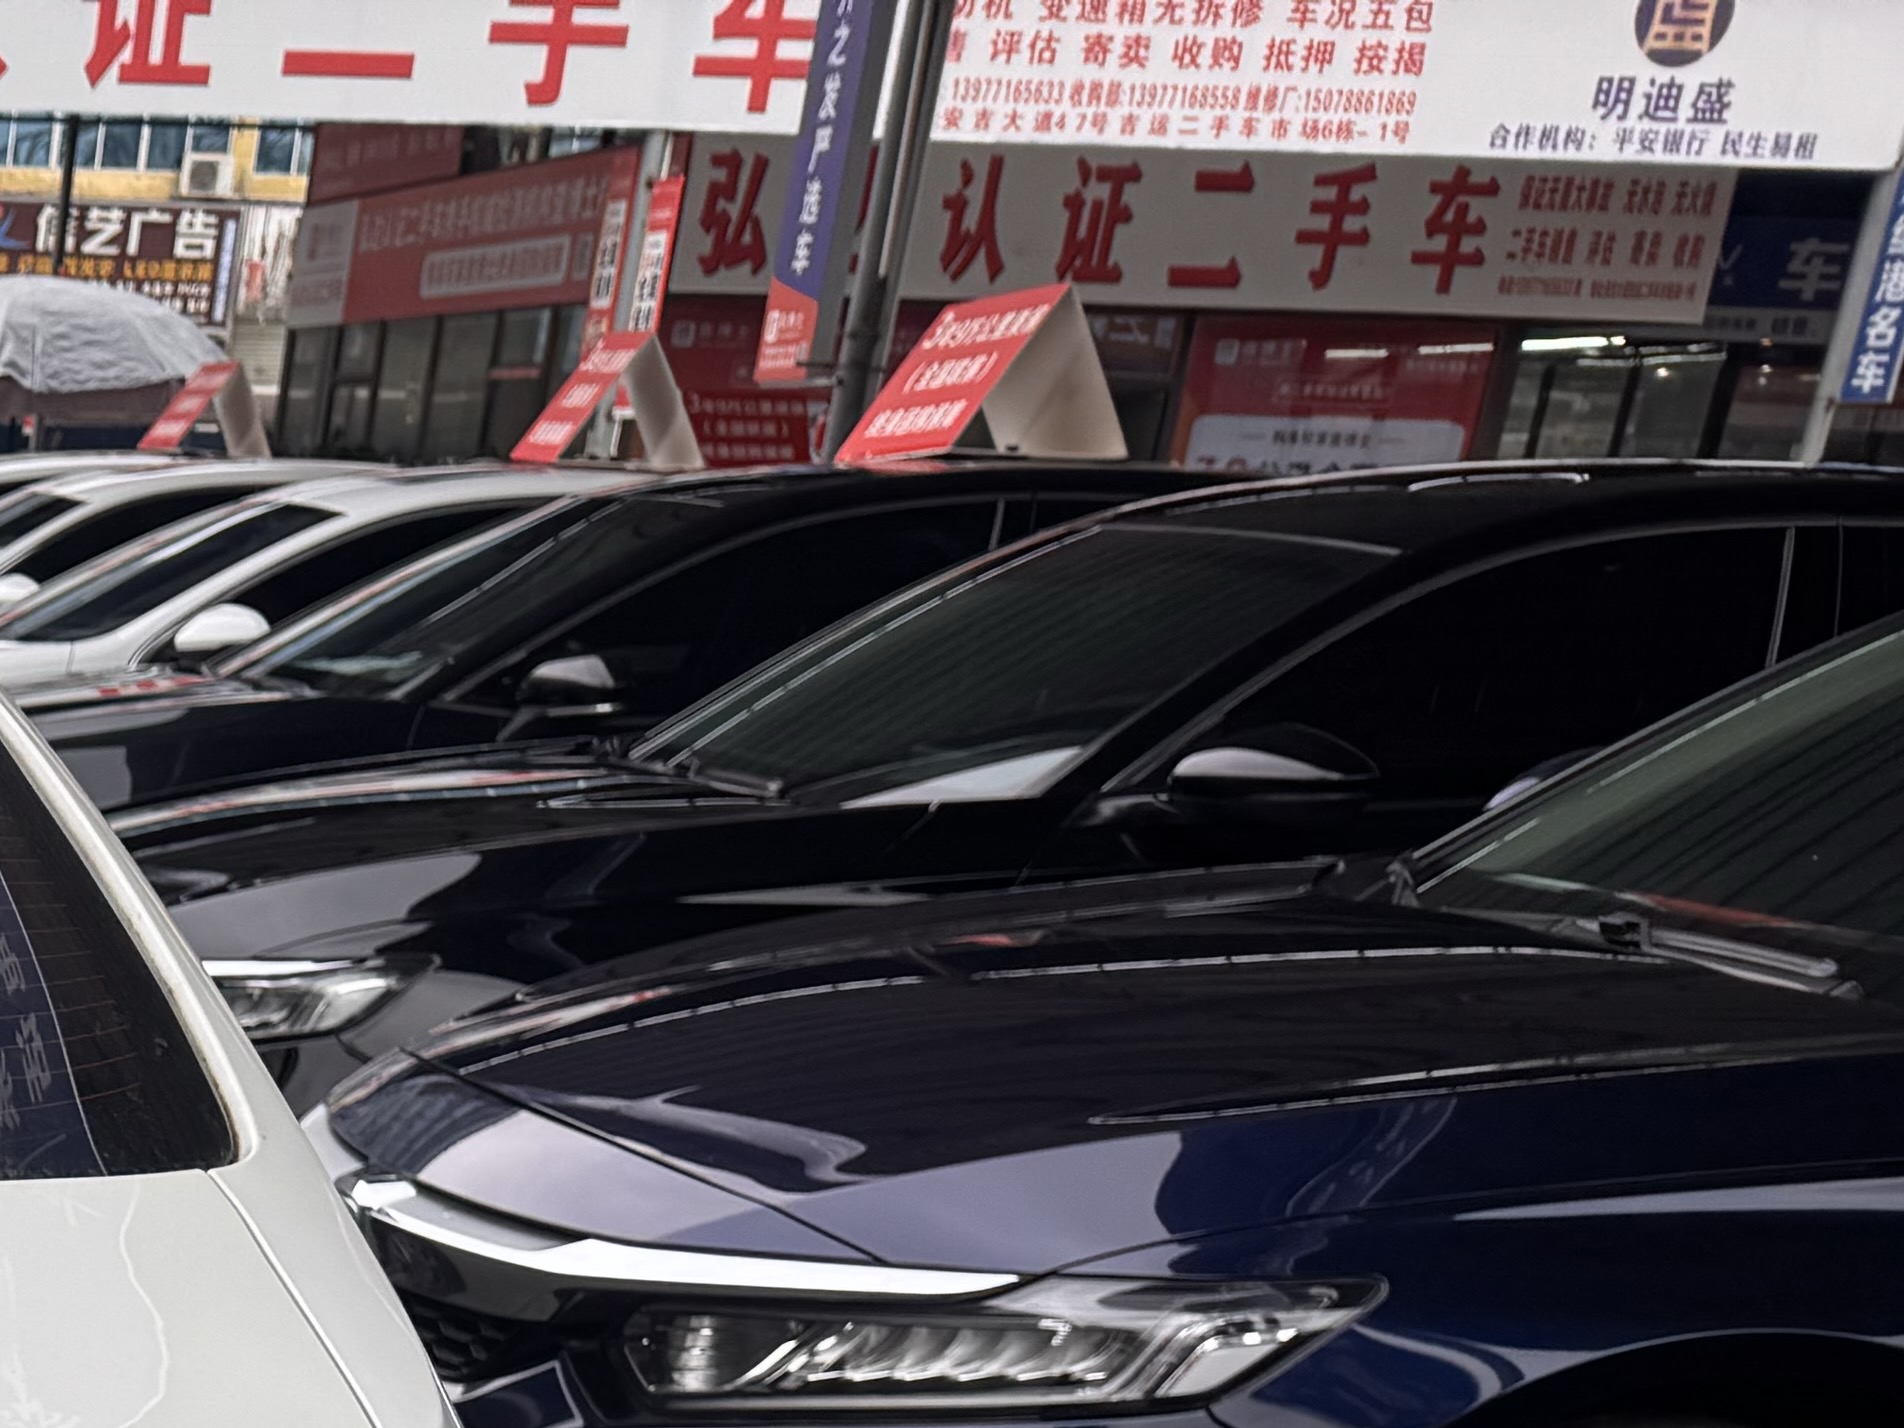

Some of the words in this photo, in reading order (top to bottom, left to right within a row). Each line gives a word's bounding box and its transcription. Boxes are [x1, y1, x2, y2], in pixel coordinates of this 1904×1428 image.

[1286, 0, 1434, 33] 车况五包
[989, 29, 1062, 65] 评估
[1082, 32, 1151, 69] 寄卖
[1171, 34, 1244, 72] 收购
[1262, 36, 1336, 74] 抵押
[1353, 39, 1427, 77] 按揭
[1592, 75, 1736, 125] 明迪盛
[1611, 127, 1711, 157] 平安银行
[696, 149, 1501, 296] 弘认证二手车
